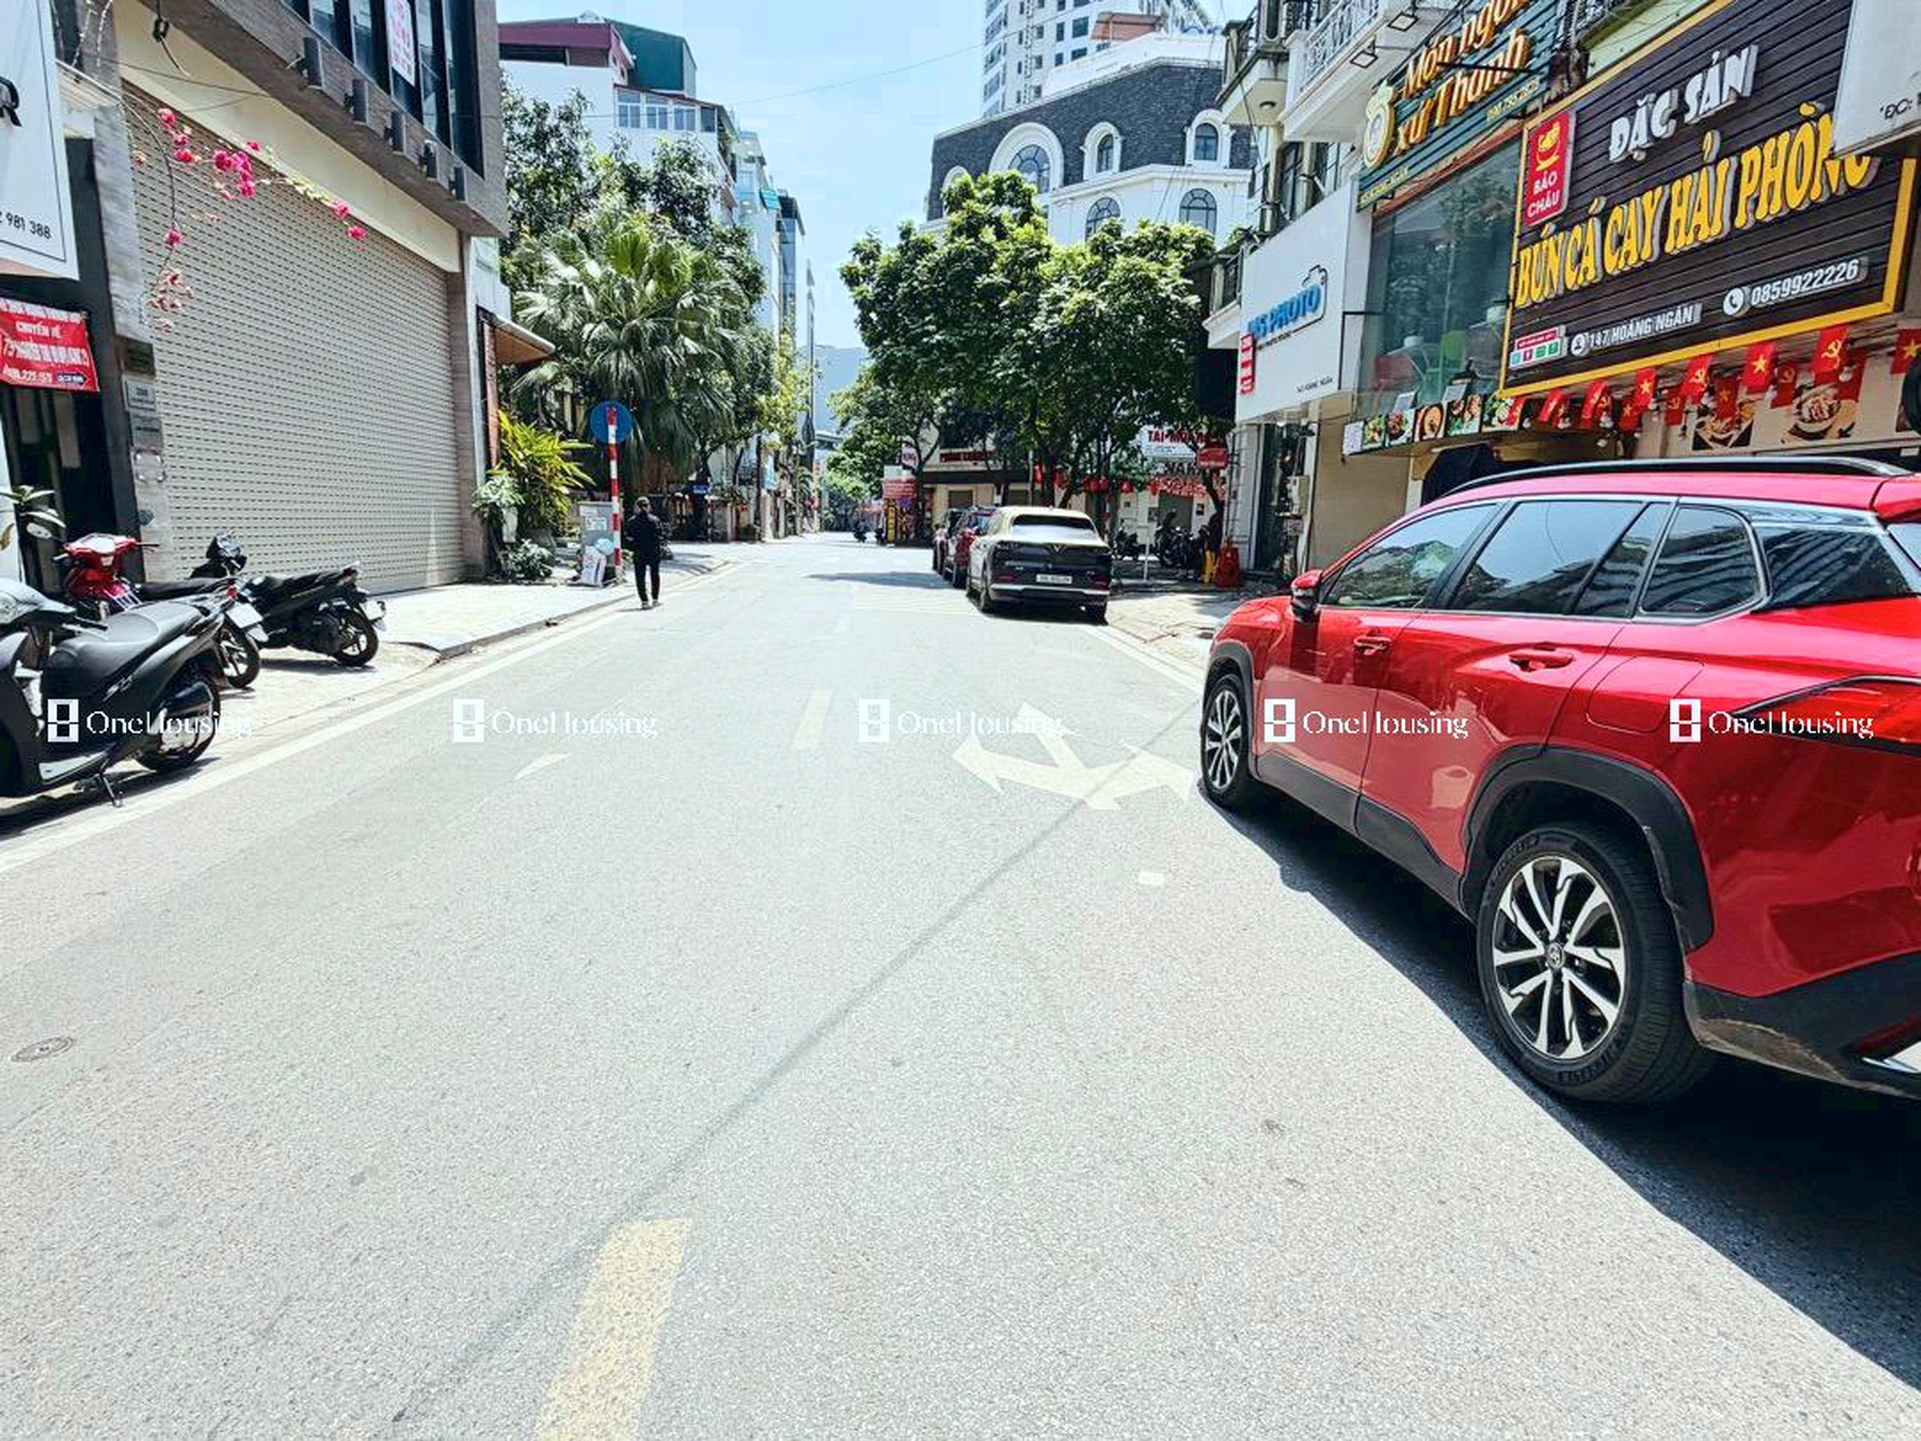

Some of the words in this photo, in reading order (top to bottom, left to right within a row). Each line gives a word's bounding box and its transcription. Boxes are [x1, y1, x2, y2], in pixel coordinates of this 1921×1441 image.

[1433, 28, 1530, 128] Thanh
[1684, 46, 1757, 124] SẢN
[6, 212, 25, 231] 981
[29, 220, 51, 239] 388
[1514, 223, 1565, 307] BÚN
[1565, 198, 1600, 291] CÁ
[1603, 186, 1664, 275] CAY
[1665, 131, 1732, 253] HẢI
[1751, 258, 1860, 307] 0859922226
